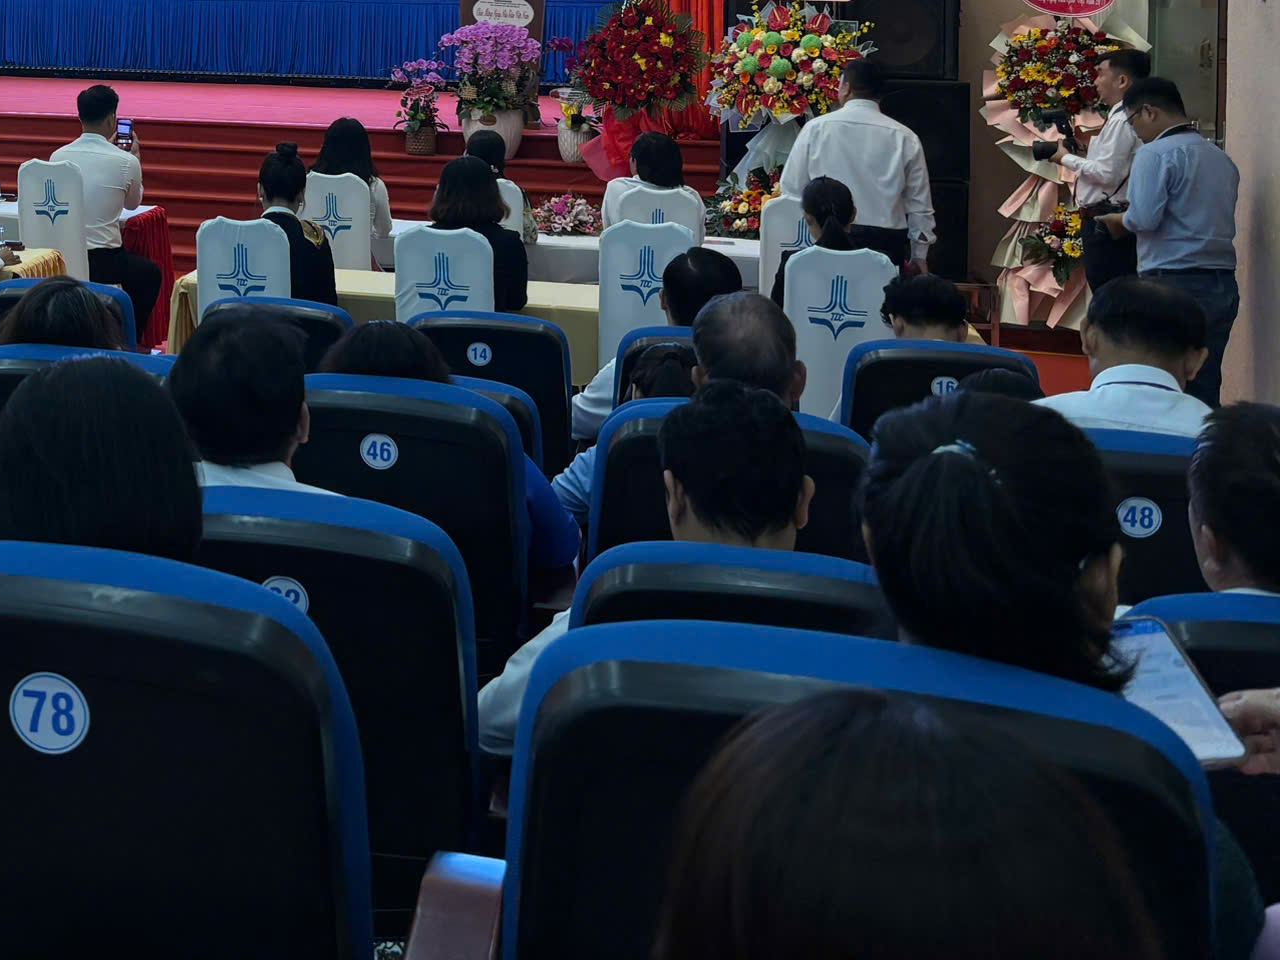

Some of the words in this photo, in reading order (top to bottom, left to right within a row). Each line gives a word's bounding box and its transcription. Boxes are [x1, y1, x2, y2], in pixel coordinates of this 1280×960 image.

[236, 278, 248, 287] TDC
[640, 280, 653, 289] TDC
[437, 287, 450, 296] TDC
[830, 312, 845, 322] TDC
[471, 346, 488, 361] 14
[936, 381, 957, 395] 16
[366, 440, 393, 462] 46
[1122, 505, 1155, 529] 48
[22, 689, 76, 737] 78
